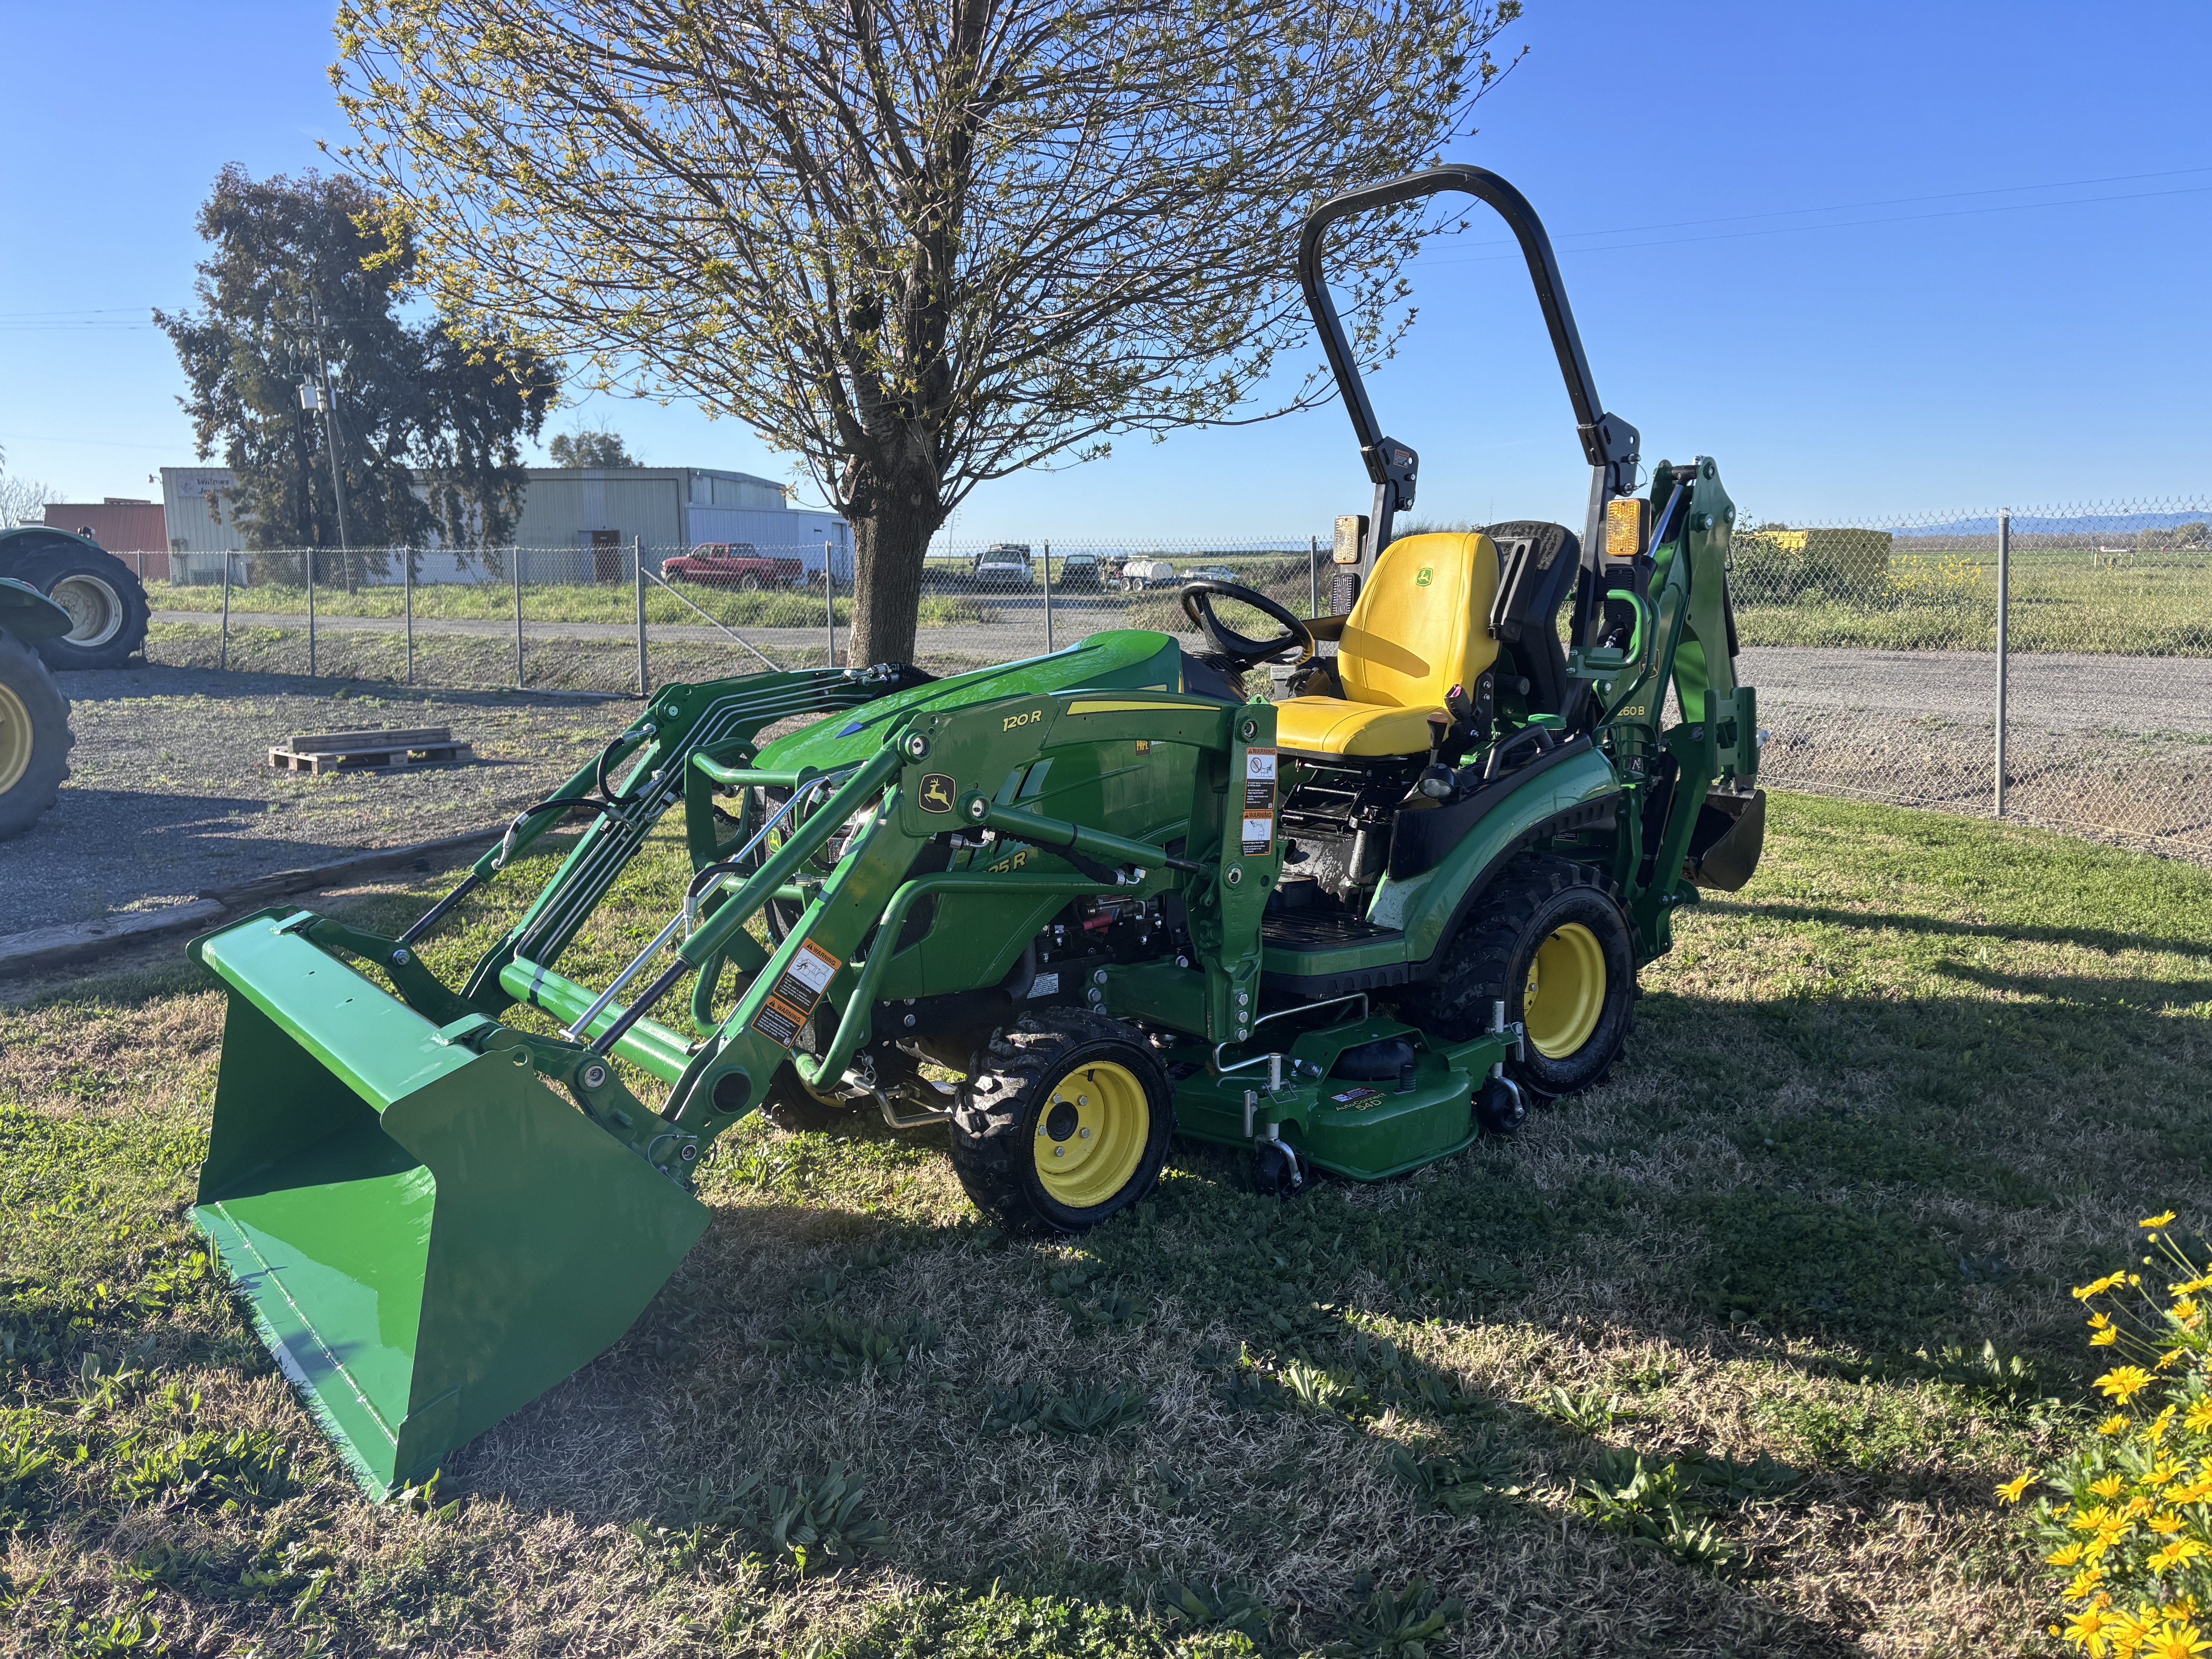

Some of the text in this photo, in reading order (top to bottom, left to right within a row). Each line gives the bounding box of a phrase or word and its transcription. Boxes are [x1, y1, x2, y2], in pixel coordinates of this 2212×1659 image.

[1638, 706, 1645, 716] B
[1003, 710, 1042, 732] 120 R
[1013, 852, 1026, 870] R
[813, 947, 836, 966] WARNING
[777, 1004, 801, 1023] WARNING
[1355, 1100, 1382, 1111] 54D
